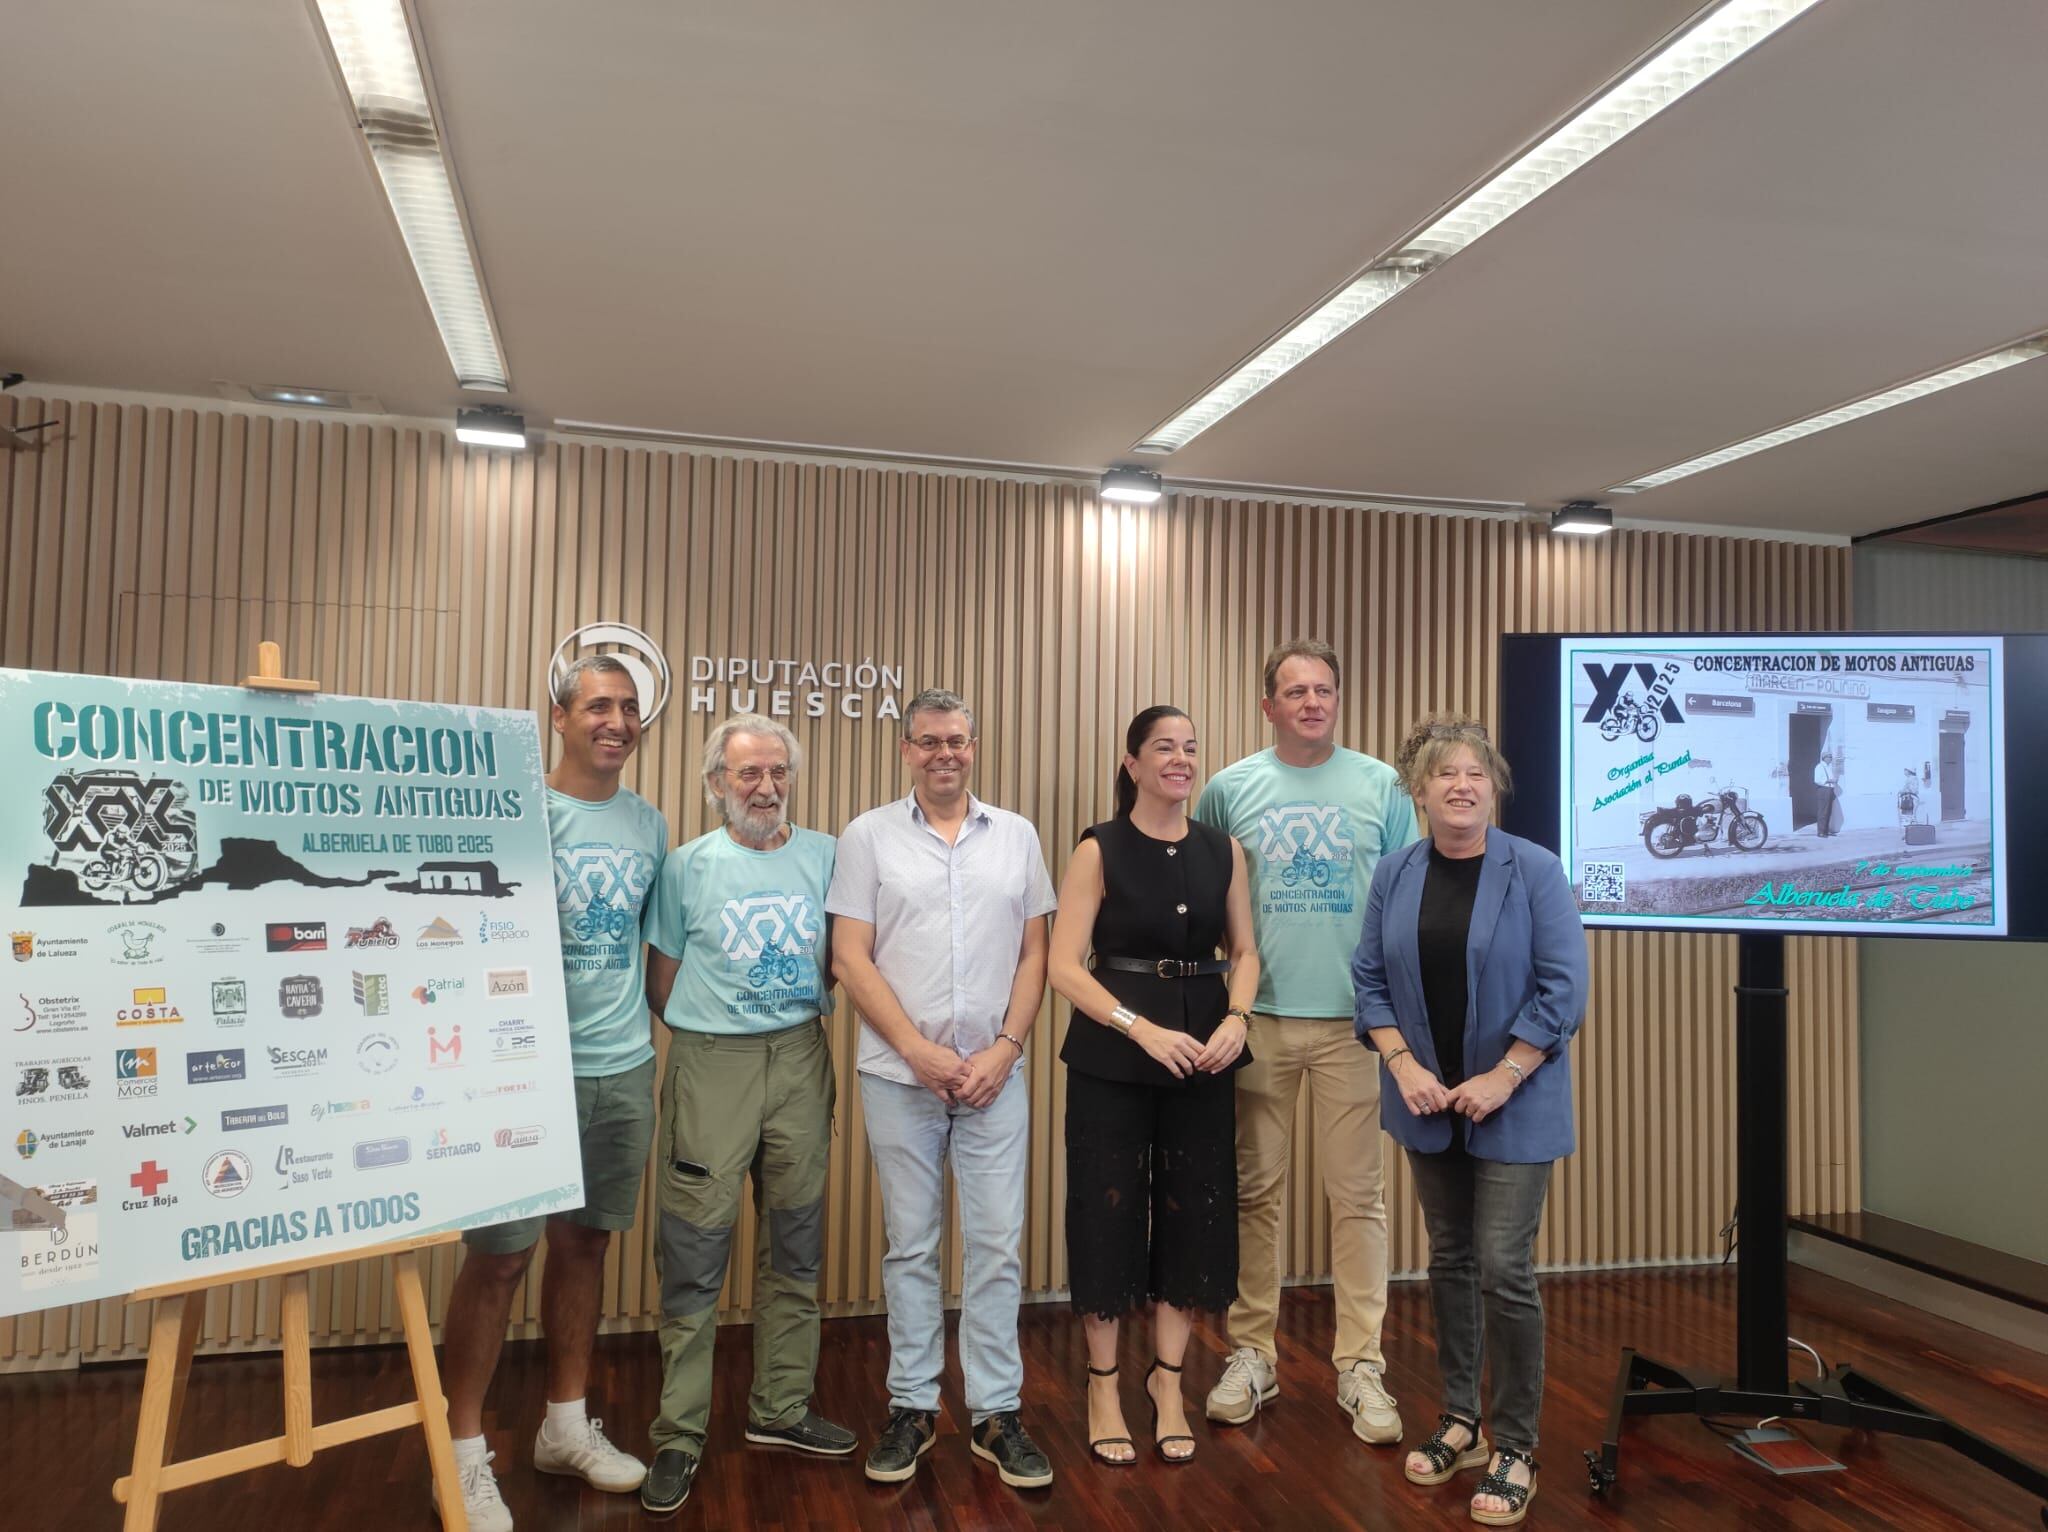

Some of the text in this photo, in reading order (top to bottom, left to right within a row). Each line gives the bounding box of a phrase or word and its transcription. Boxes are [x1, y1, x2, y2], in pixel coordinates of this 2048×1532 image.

[1693, 655, 1975, 672] CONCENTRACION DE MOTOS ANTIGUAS
[691, 656, 903, 690] DIPUTACIÓN
[1648, 661, 1681, 711] 2025
[691, 687, 901, 720] HUESCA
[34, 701, 499, 778] CONCENTRACION
[1607, 752, 1655, 781] Organiza
[199, 778, 524, 821] DE MOTOS ANTIGUAS
[1592, 779, 1642, 812] Asociación
[161, 842, 187, 852] 2025
[302, 832, 494, 854] ALBERUELA DE TUBO 2025
[1270, 889, 1345, 901] CONCENTRACION
[1744, 881, 1975, 910] Alberuela de Tubo
[1262, 903, 1353, 914] DE MOTOS ANTIGUAS
[293, 926, 325, 940] barri
[490, 921, 515, 931] FISIO
[36, 937, 89, 948] Ayuntamiento
[48, 950, 78, 958] Lalueza
[427, 976, 465, 991] Patrial
[492, 979, 525, 993] Azón
[38, 996, 80, 1005] Obstetrix
[286, 995, 317, 1008] CAVERN
[736, 985, 814, 1003] CONCENTRACION
[117, 1006, 181, 1021] COSTA
[727, 1003, 740, 1015] DE
[742, 1003, 777, 1014] MOTOS
[270, 1047, 328, 1064] SESCAM
[40, 1128, 95, 1142] Ayuntamiento
[121, 1120, 177, 1138] Valmet
[60, 1137, 87, 1148] Lanaja
[284, 1148, 334, 1165] Restaurante
[426, 1142, 482, 1161] SERTAGRO
[291, 1167, 333, 1184] Saso Verde
[122, 1194, 179, 1211] Cruz Roja
[181, 1192, 421, 1262] GRACIAS A TODOS
[21, 1242, 98, 1268] BERDÚN
